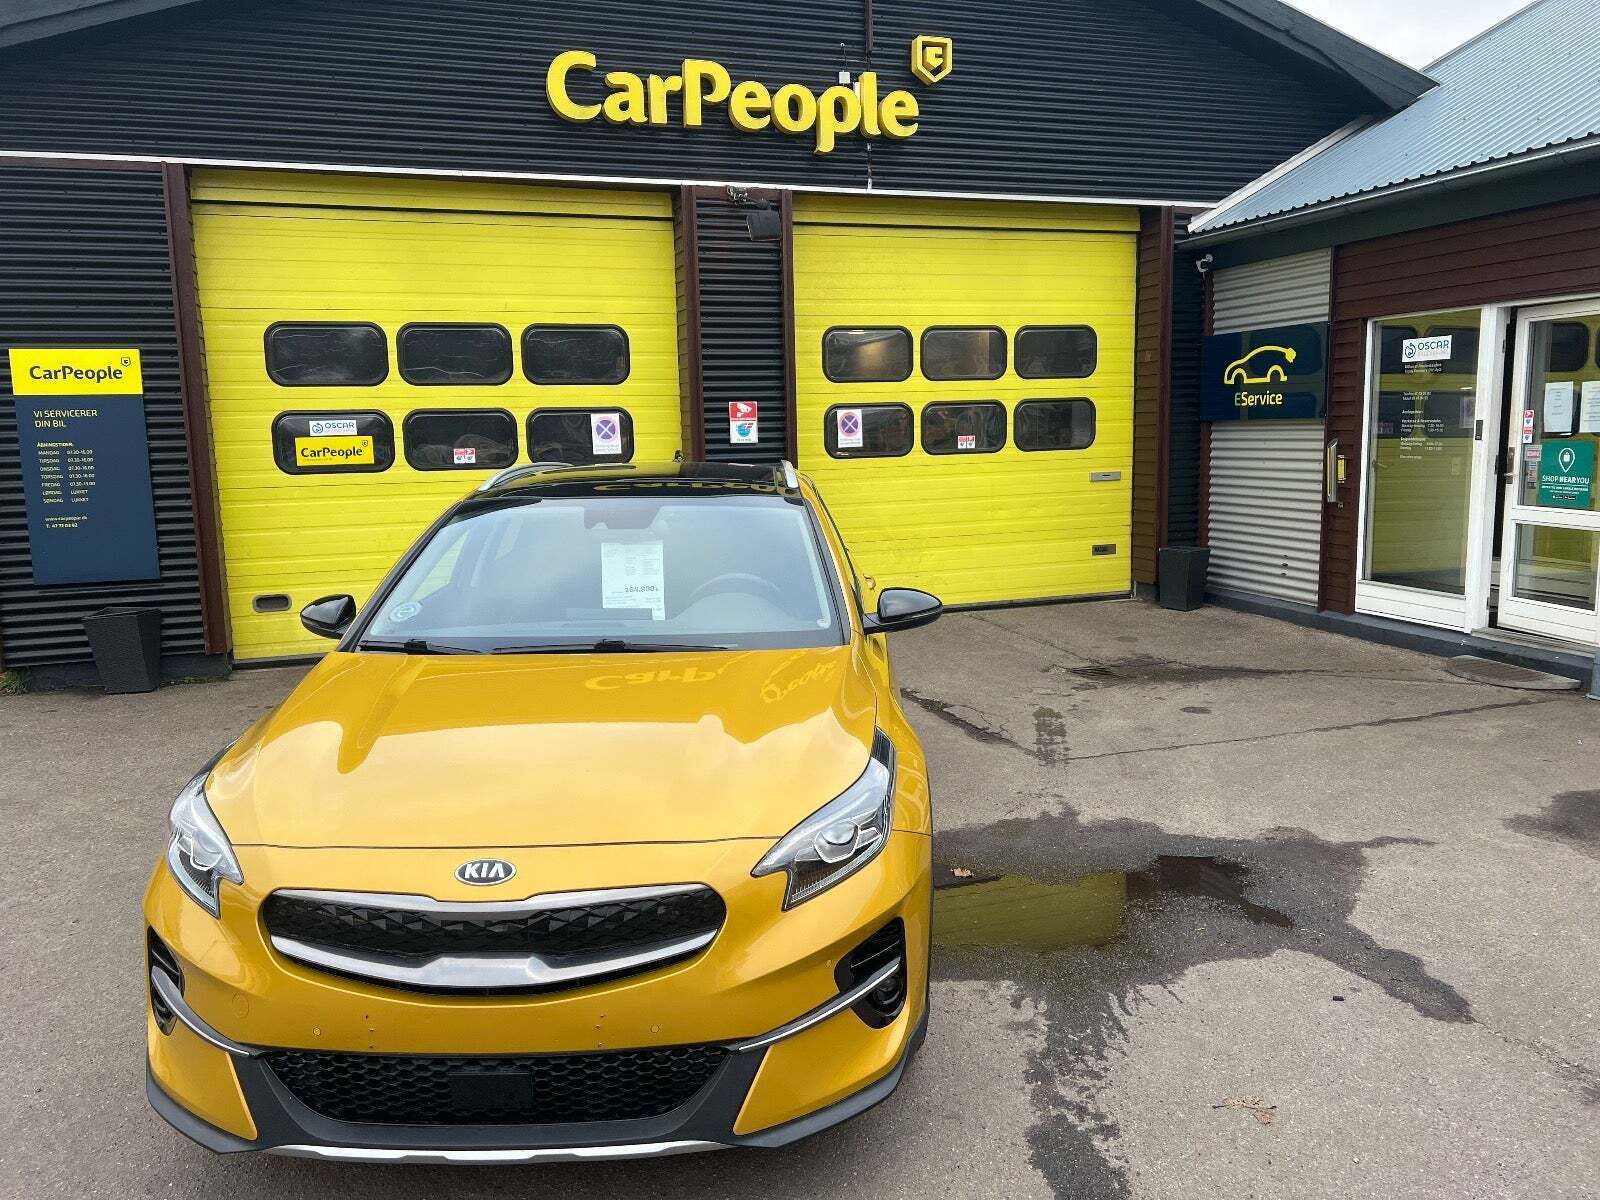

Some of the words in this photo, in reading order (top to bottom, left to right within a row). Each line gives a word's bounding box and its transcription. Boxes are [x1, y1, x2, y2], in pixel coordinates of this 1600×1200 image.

[546, 50, 919, 153] CarPeople
[1417, 339, 1450, 351] OSCAR
[29, 365, 123, 383] CarPeople
[1234, 391, 1283, 406] EService
[33, 410, 43, 418] VI
[45, 409, 98, 418] SERVICERER
[35, 420, 51, 428] DIN
[53, 420, 67, 428] BIL
[301, 446, 362, 459] CarPeople
[1559, 476, 1576, 484] NEAR
[464, 863, 505, 878] KIA
